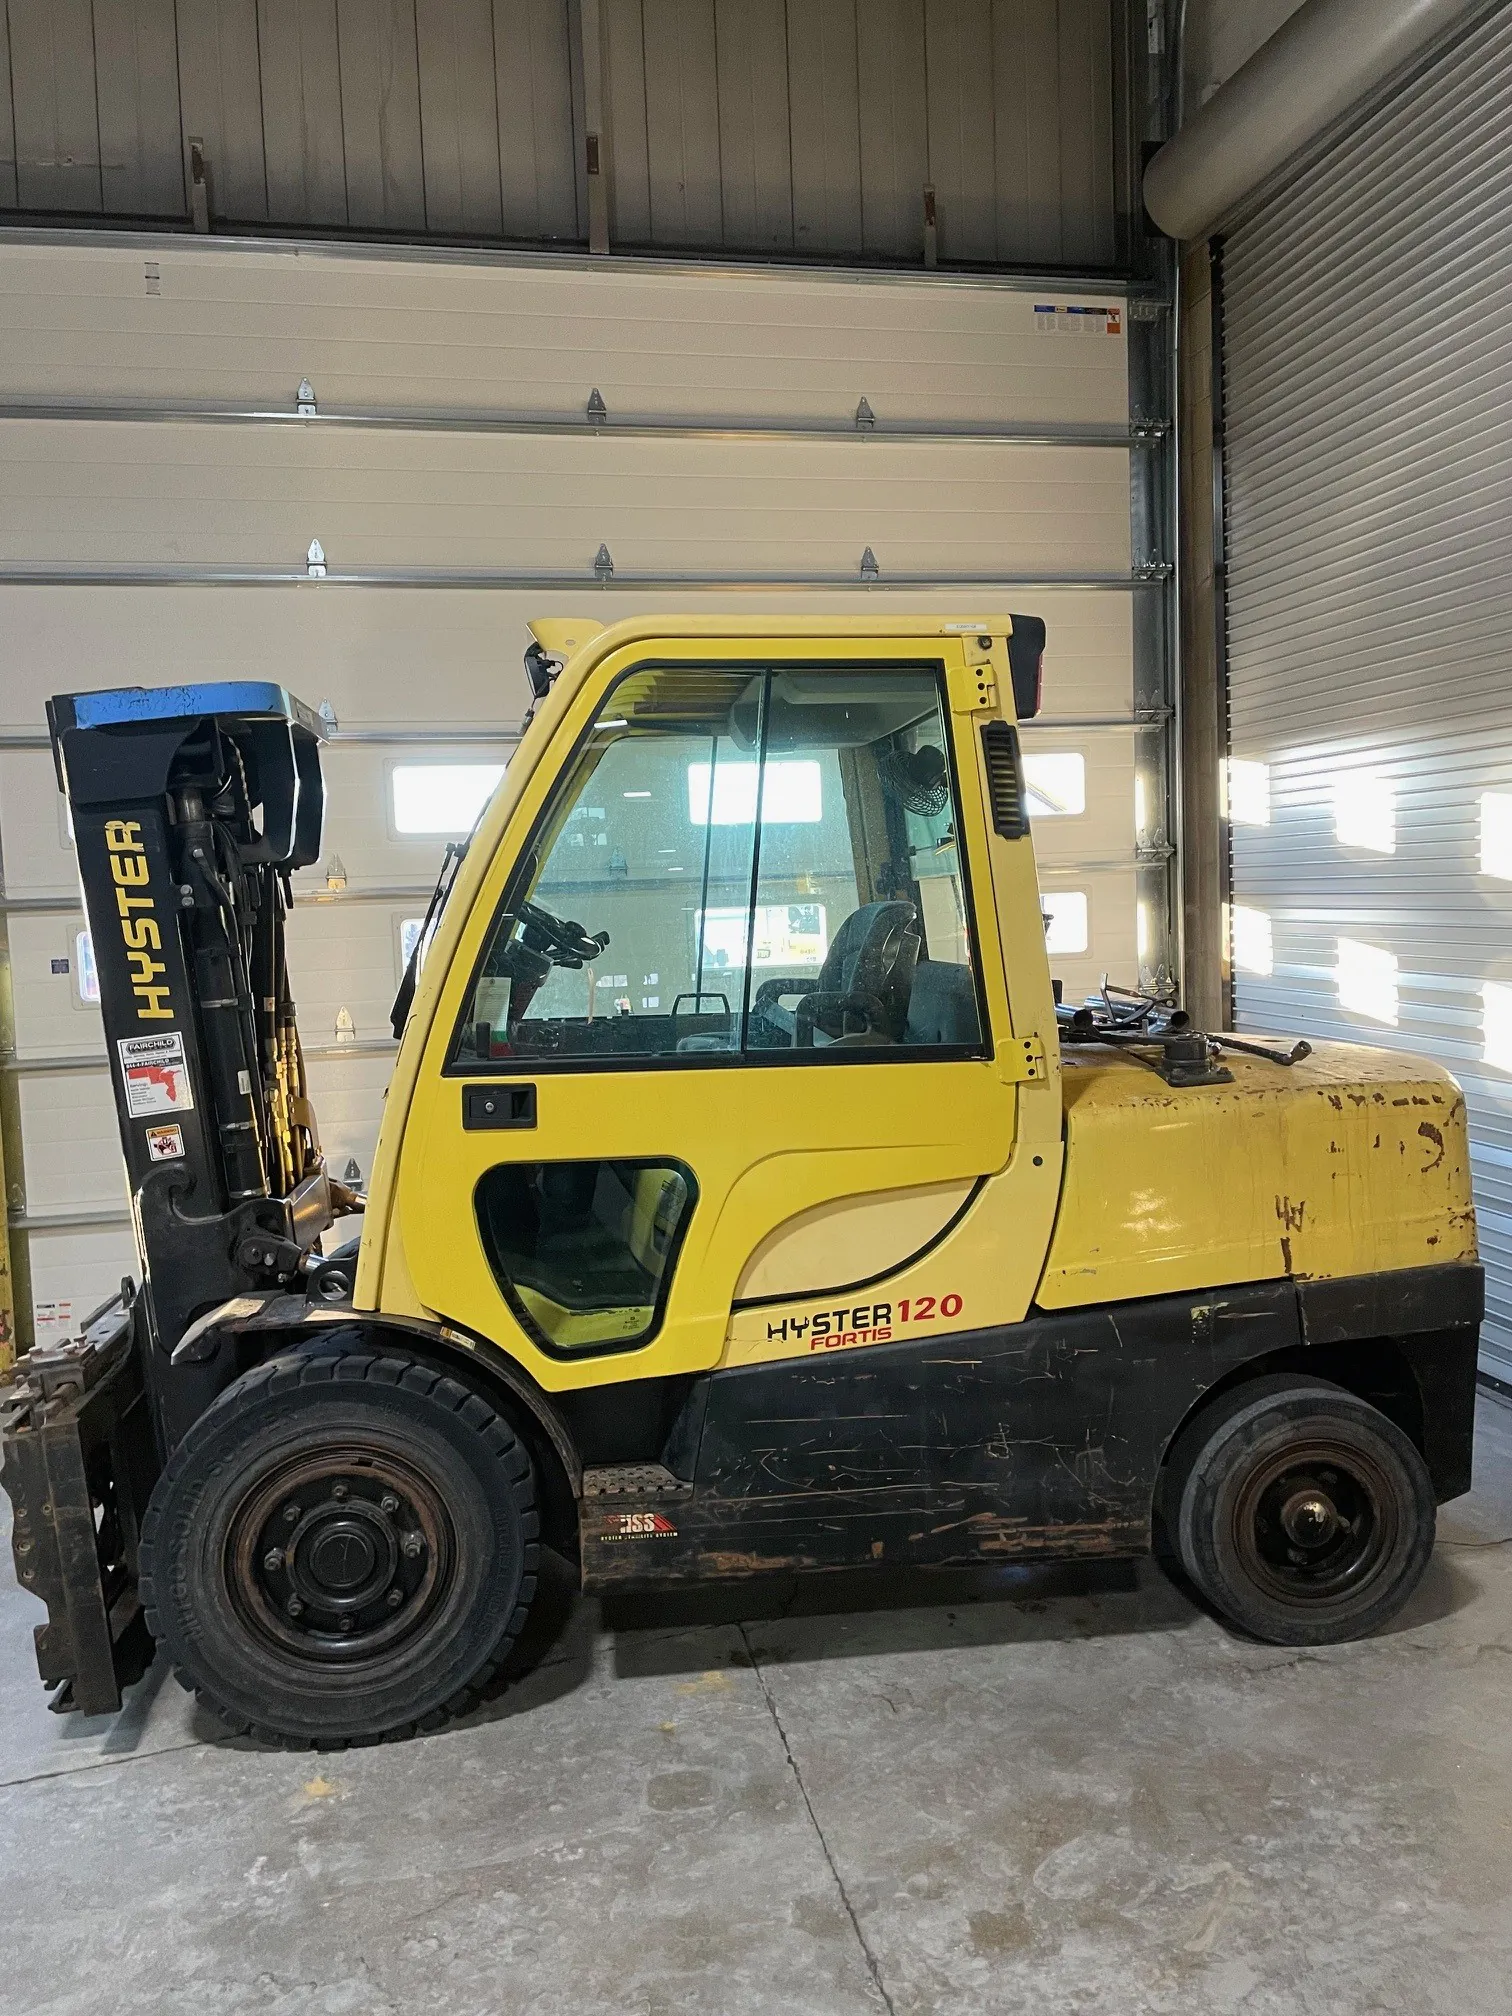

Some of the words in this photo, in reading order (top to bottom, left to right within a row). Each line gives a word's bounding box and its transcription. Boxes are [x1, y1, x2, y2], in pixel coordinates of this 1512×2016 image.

[105, 820, 175, 1019] HYSTER
[129, 1039, 173, 1051] FAIRCHILD
[767, 1303, 892, 1343] HYSTER
[897, 1294, 963, 1323] 120
[810, 1326, 892, 1350] FORTIS
